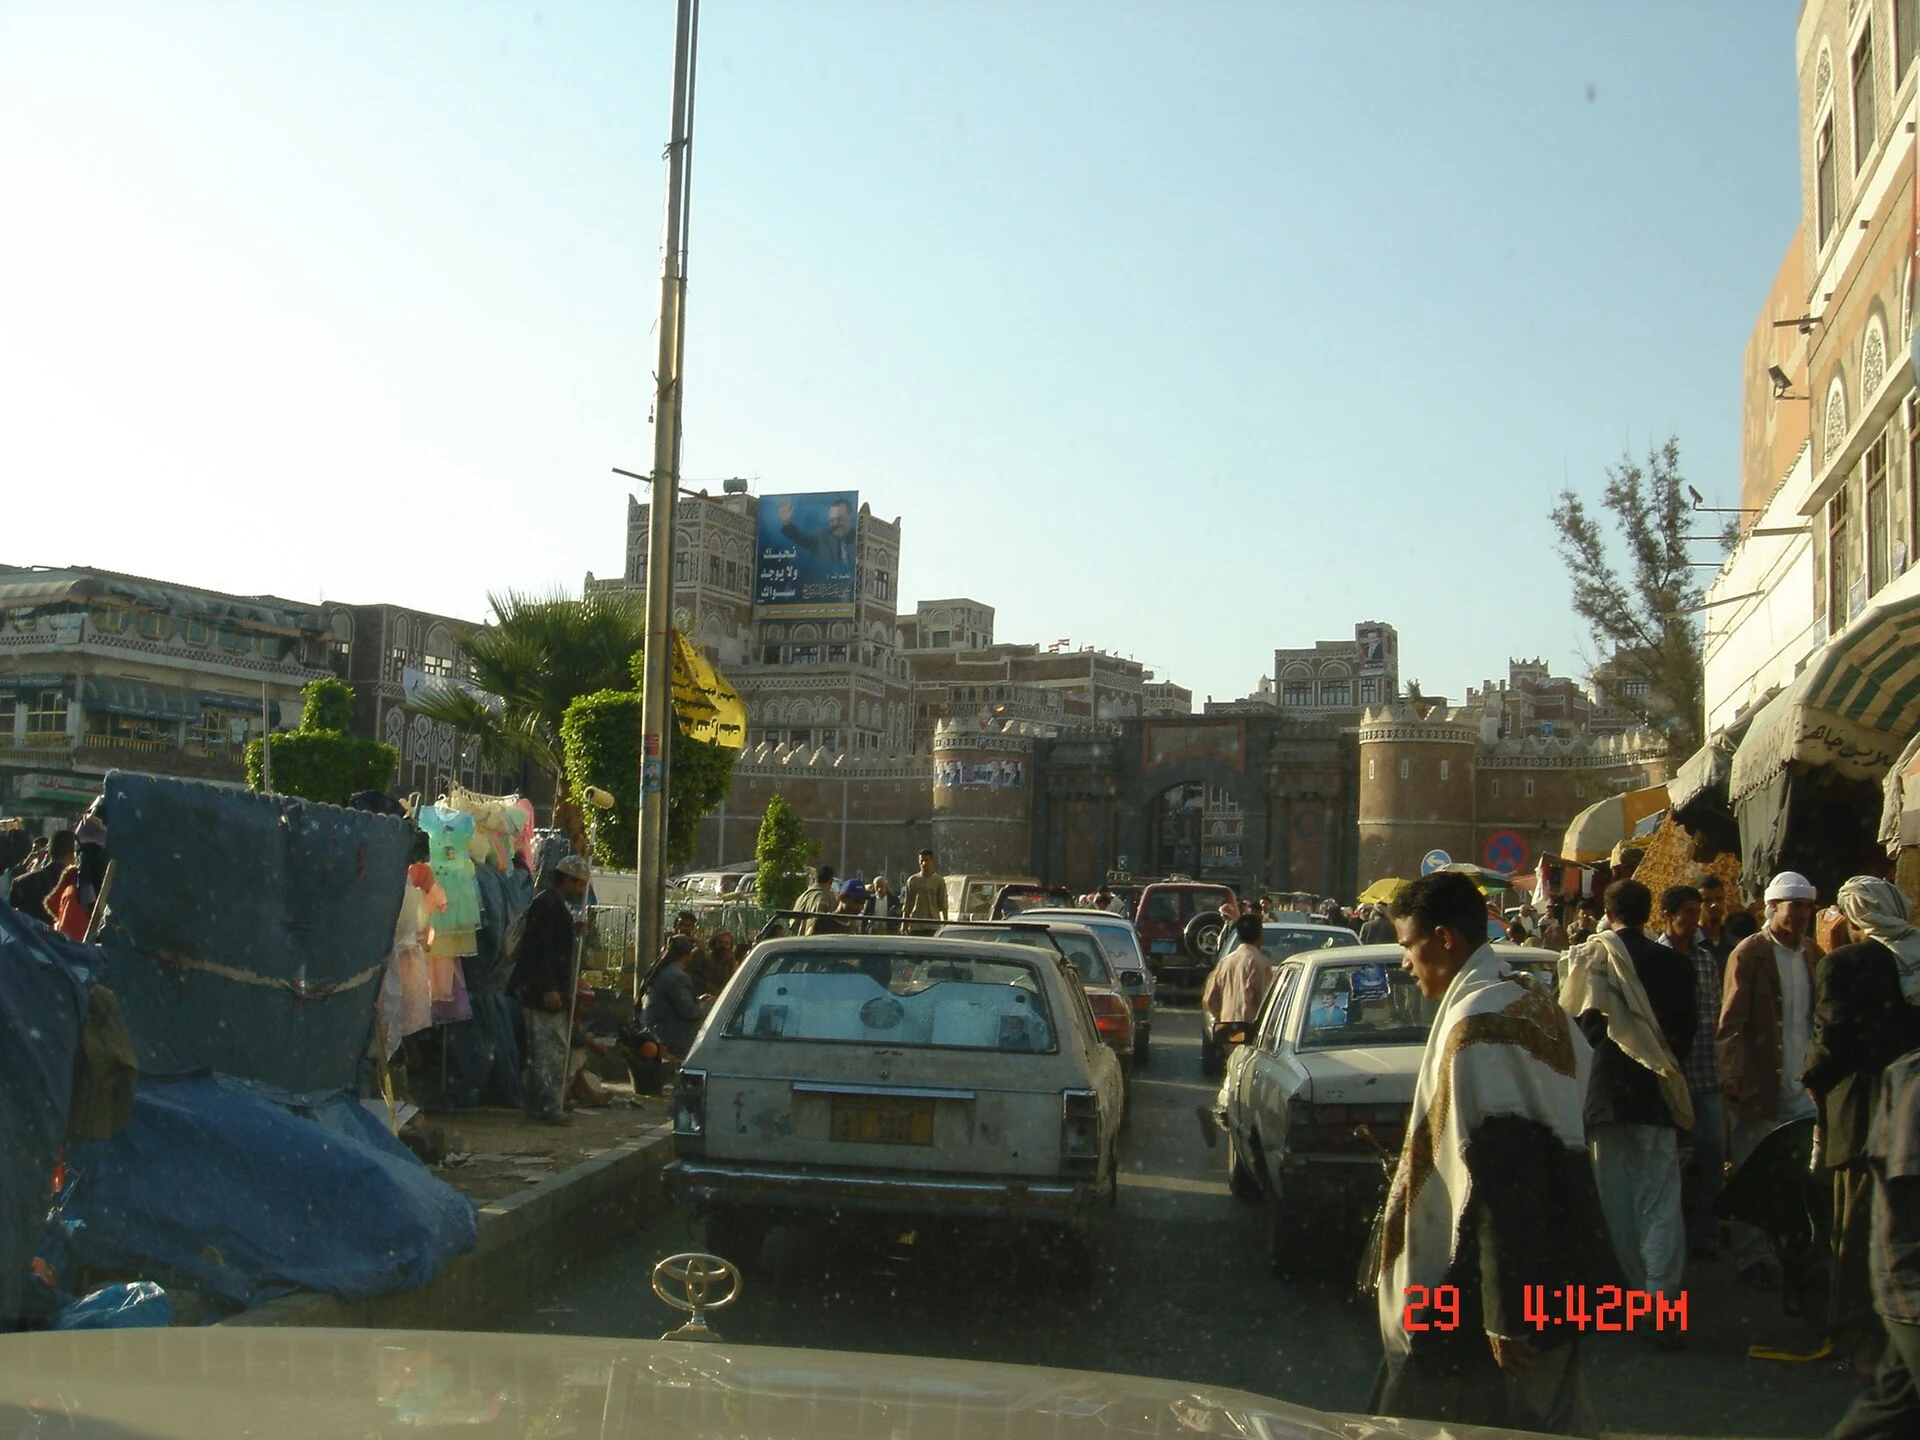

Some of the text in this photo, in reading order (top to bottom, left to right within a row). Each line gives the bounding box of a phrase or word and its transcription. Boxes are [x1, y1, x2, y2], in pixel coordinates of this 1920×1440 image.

[763, 546, 797, 562] نحبك
[760, 565, 798, 582] ولا يوجد
